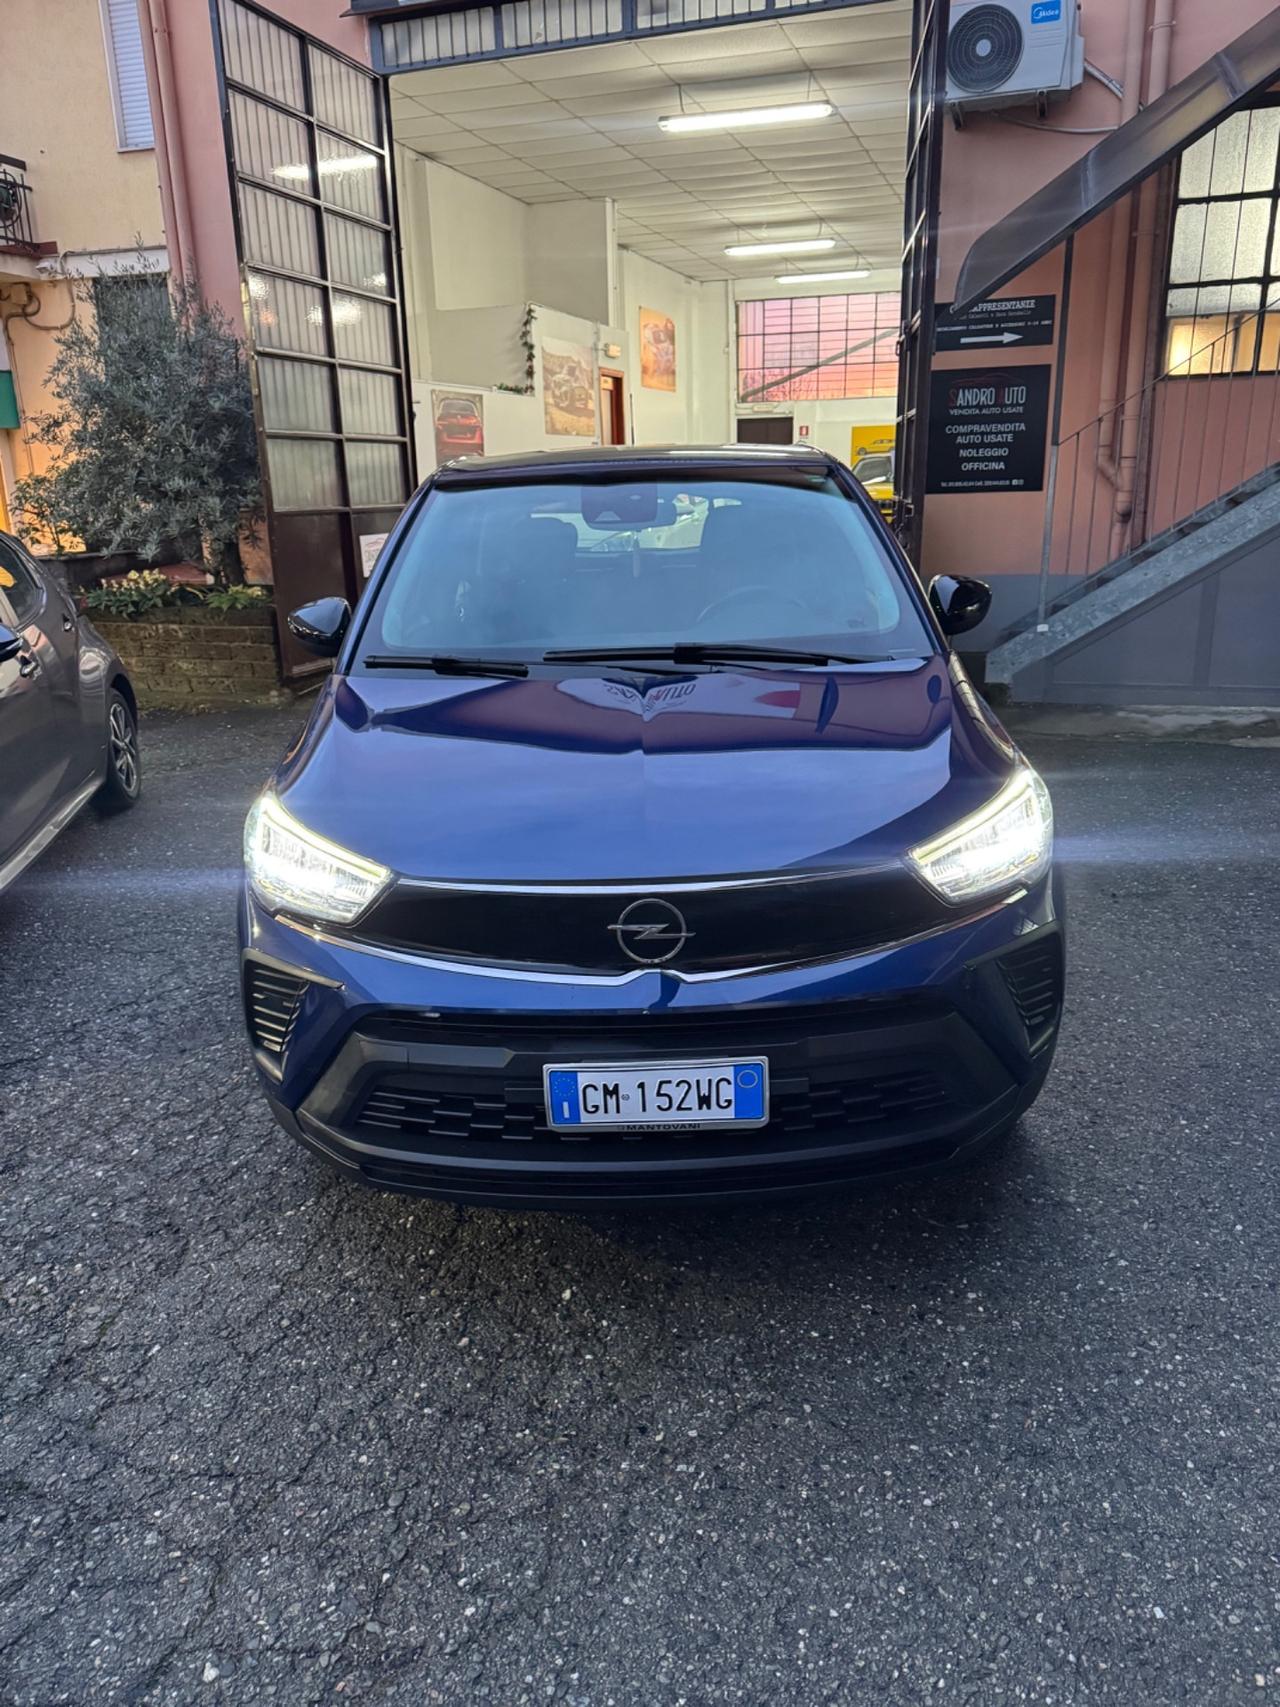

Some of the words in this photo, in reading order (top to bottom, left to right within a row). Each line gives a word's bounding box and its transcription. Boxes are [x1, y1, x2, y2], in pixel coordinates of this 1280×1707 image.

[968, 299, 1036, 313] APPRESENTANZE
[948, 387, 996, 407] SANDRO
[949, 407, 980, 416] VENDITA
[981, 407, 1001, 415] AUTO
[1002, 406, 1024, 414] USATE
[945, 422, 1026, 434] COMPRAVENDITA
[956, 434, 982, 444] AUTO
[983, 433, 1014, 443] USATE
[959, 447, 1009, 458] NOLEGGIO
[961, 461, 1006, 471] OFFICINA
[581, 1083, 621, 1114] GM
[636, 1077, 733, 1113] 152WG
[626, 1123, 701, 1131] MANTOVANI
